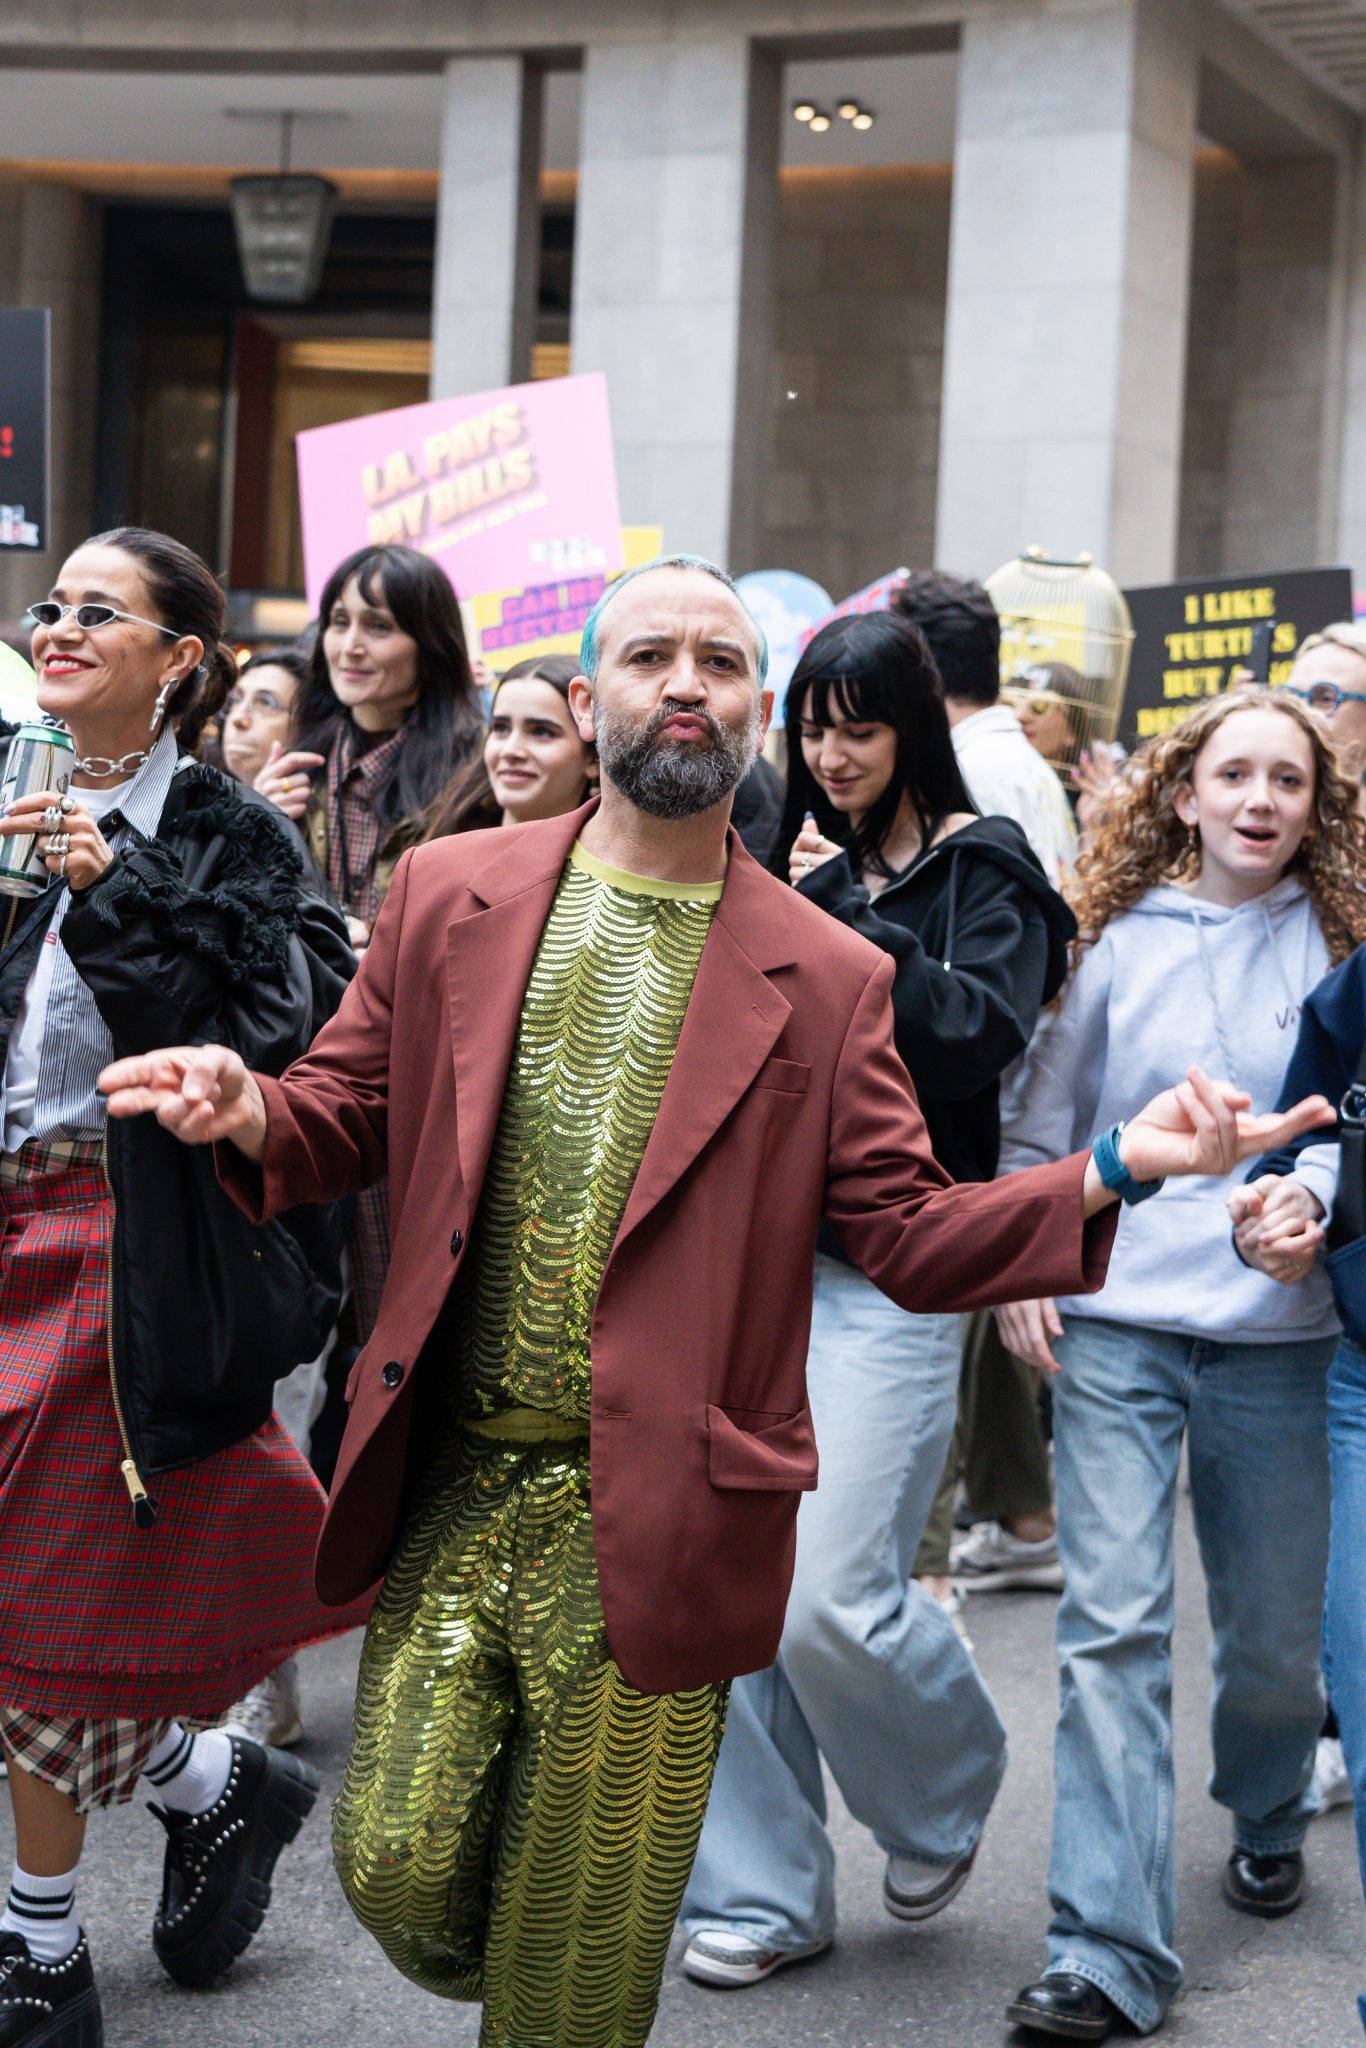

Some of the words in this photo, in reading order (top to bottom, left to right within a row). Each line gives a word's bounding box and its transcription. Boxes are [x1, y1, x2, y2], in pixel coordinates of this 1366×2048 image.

[422, 401, 525, 478] PAYS
[428, 447, 537, 526] BILLS
[1184, 594, 1200, 625] I
[1203, 587, 1276, 622] LIKE
[1164, 622, 1297, 662] TURTLS
